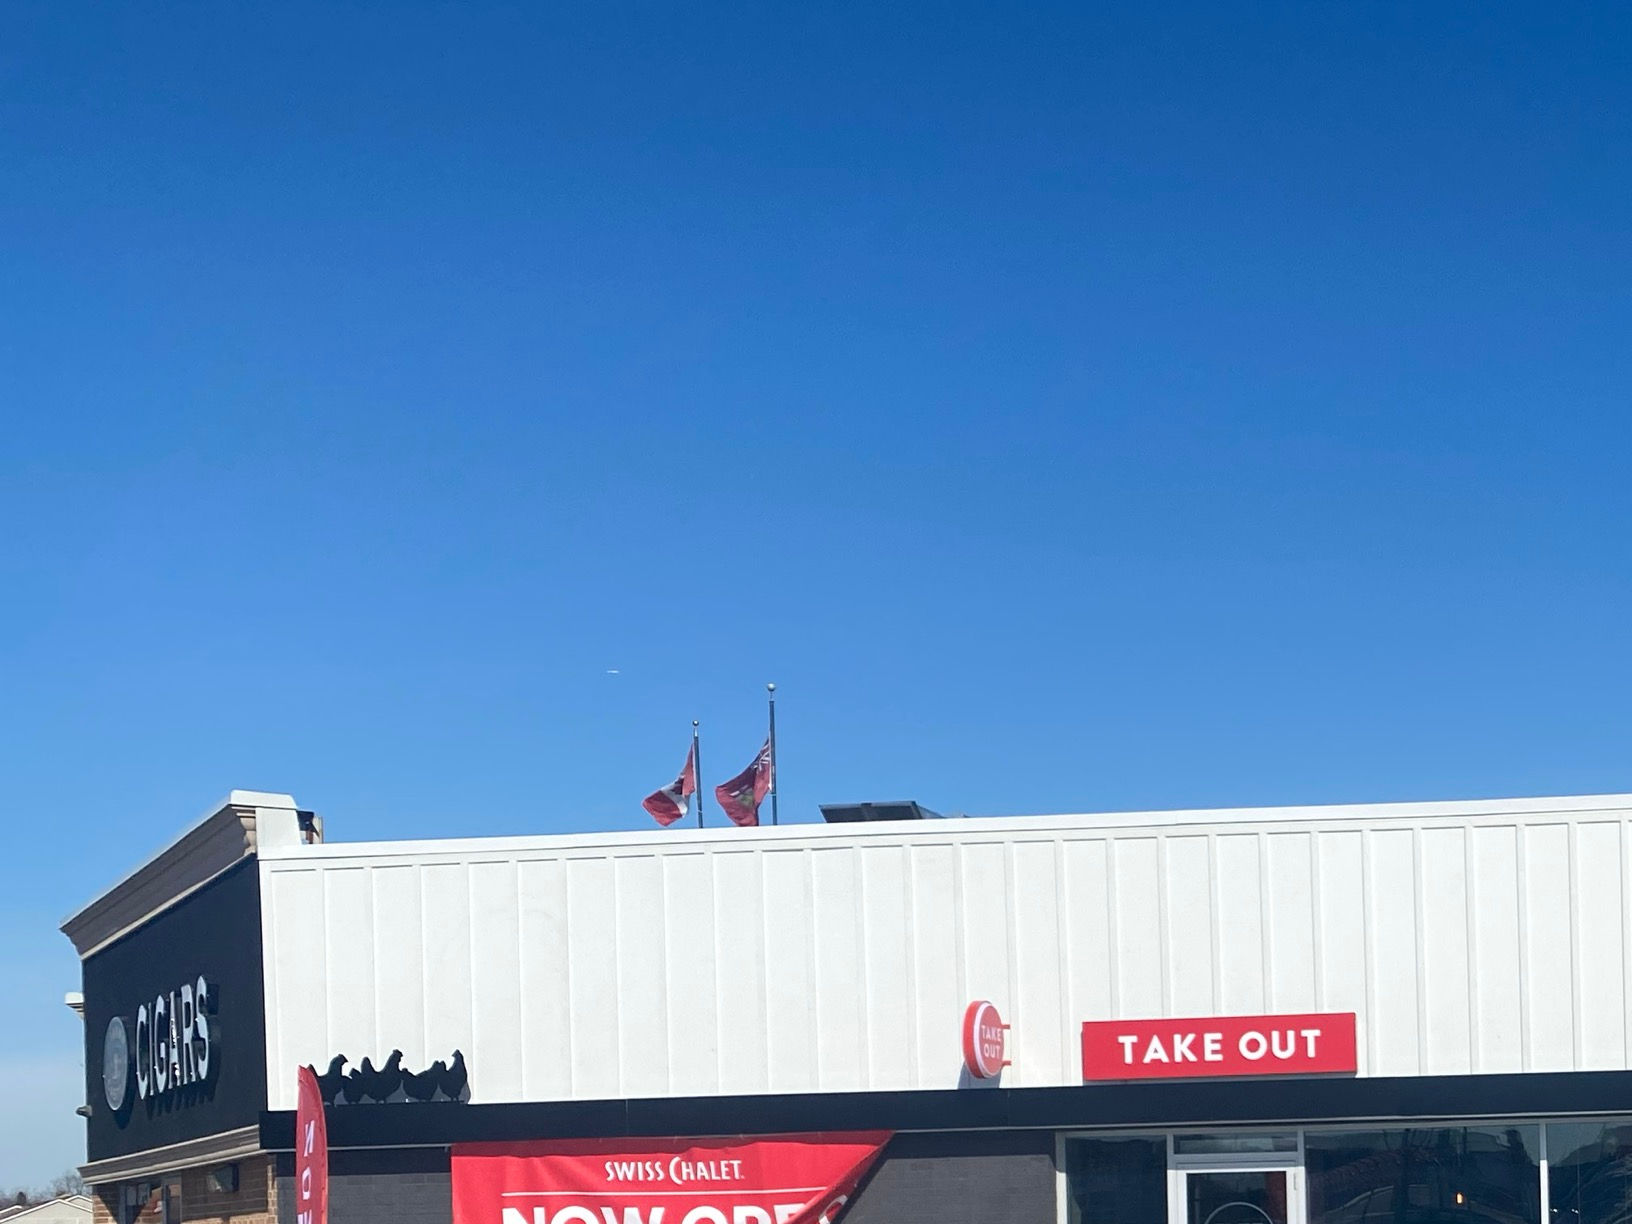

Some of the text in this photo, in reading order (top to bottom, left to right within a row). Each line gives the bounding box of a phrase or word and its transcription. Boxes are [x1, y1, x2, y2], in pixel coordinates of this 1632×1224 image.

[136, 975, 209, 1100] CIGARS
[981, 1024, 1002, 1042] TAKE
[1117, 1029, 1322, 1065] TAKE OUT
[983, 1043, 1001, 1060] OUT
[604, 1156, 743, 1185] SWISS CHALET
